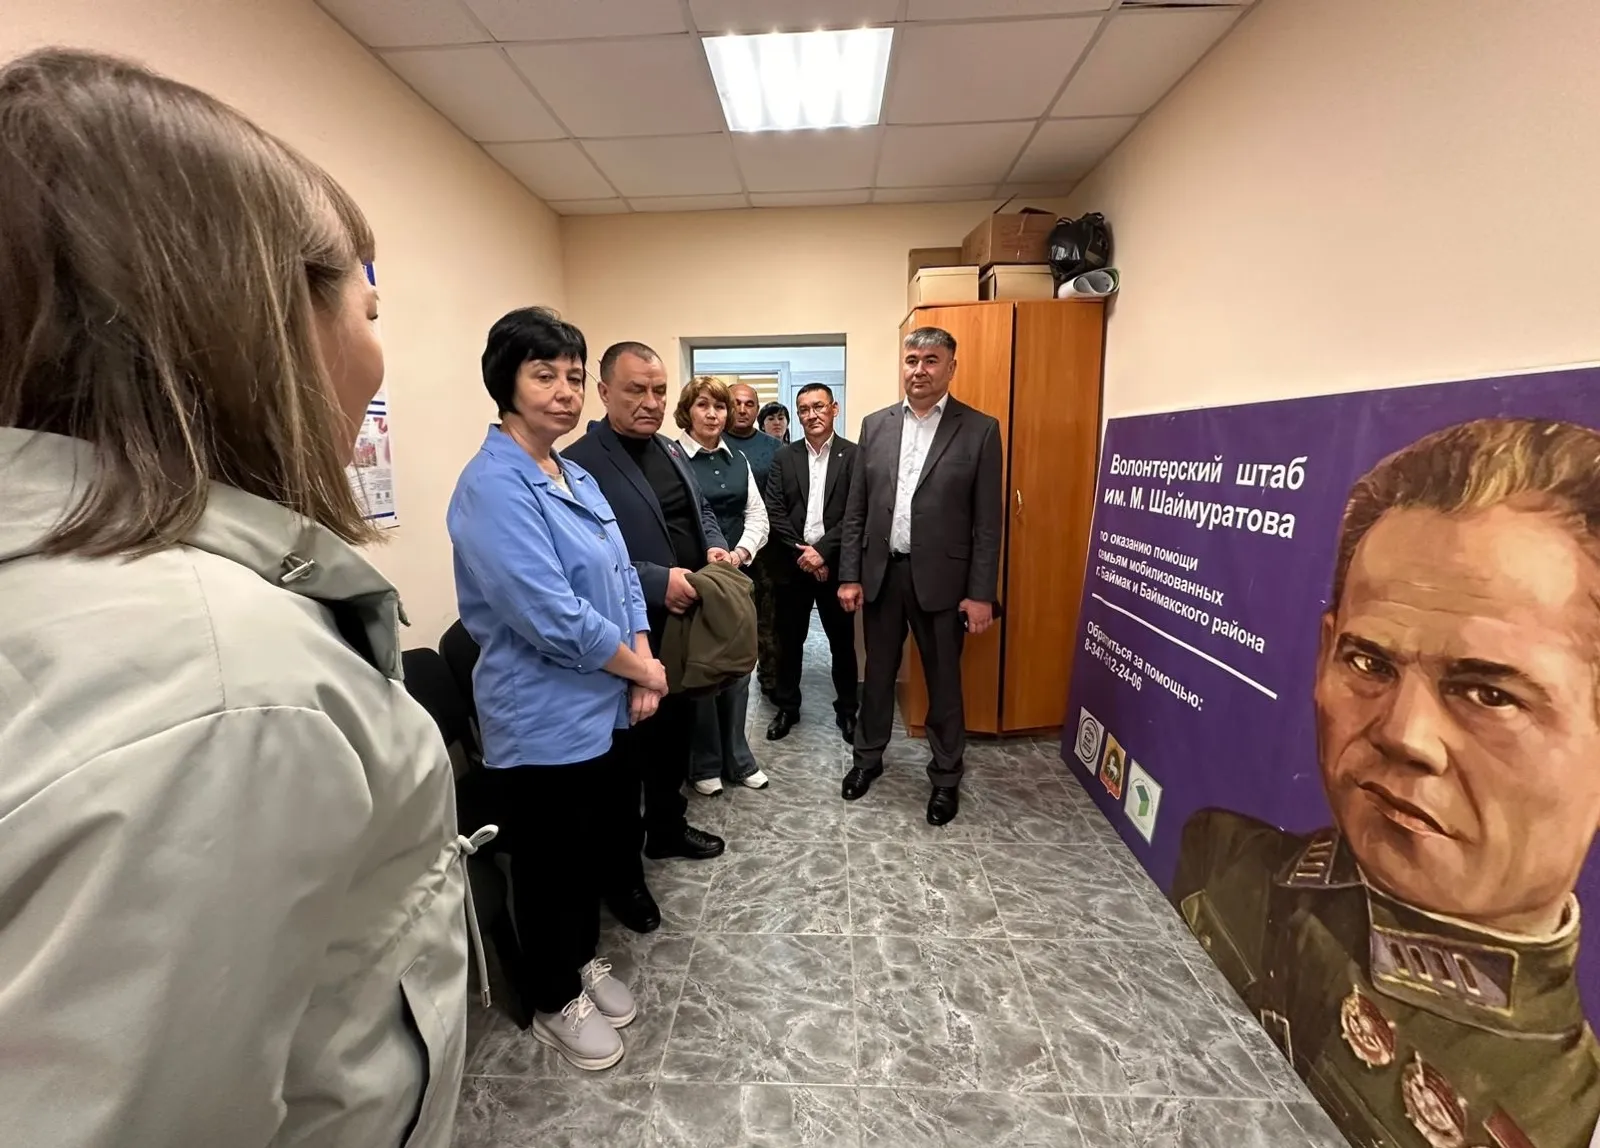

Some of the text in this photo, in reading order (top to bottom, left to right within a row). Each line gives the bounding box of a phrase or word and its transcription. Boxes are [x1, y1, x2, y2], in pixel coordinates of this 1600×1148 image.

[1110, 453, 1308, 490] Волонтерский штаб
[1103, 486, 1296, 539] им. М. Шаймуратова
[1097, 548, 1224, 607] семьям мобилизованных
[1110, 533, 1152, 556] оказанию
[1153, 546, 1199, 571] помощи
[1132, 581, 1138, 594] и
[1139, 581, 1210, 627] Баймакского
[1211, 616, 1266, 654] района
[1132, 654, 1144, 670] за
[1144, 662, 1204, 712] помощью:
